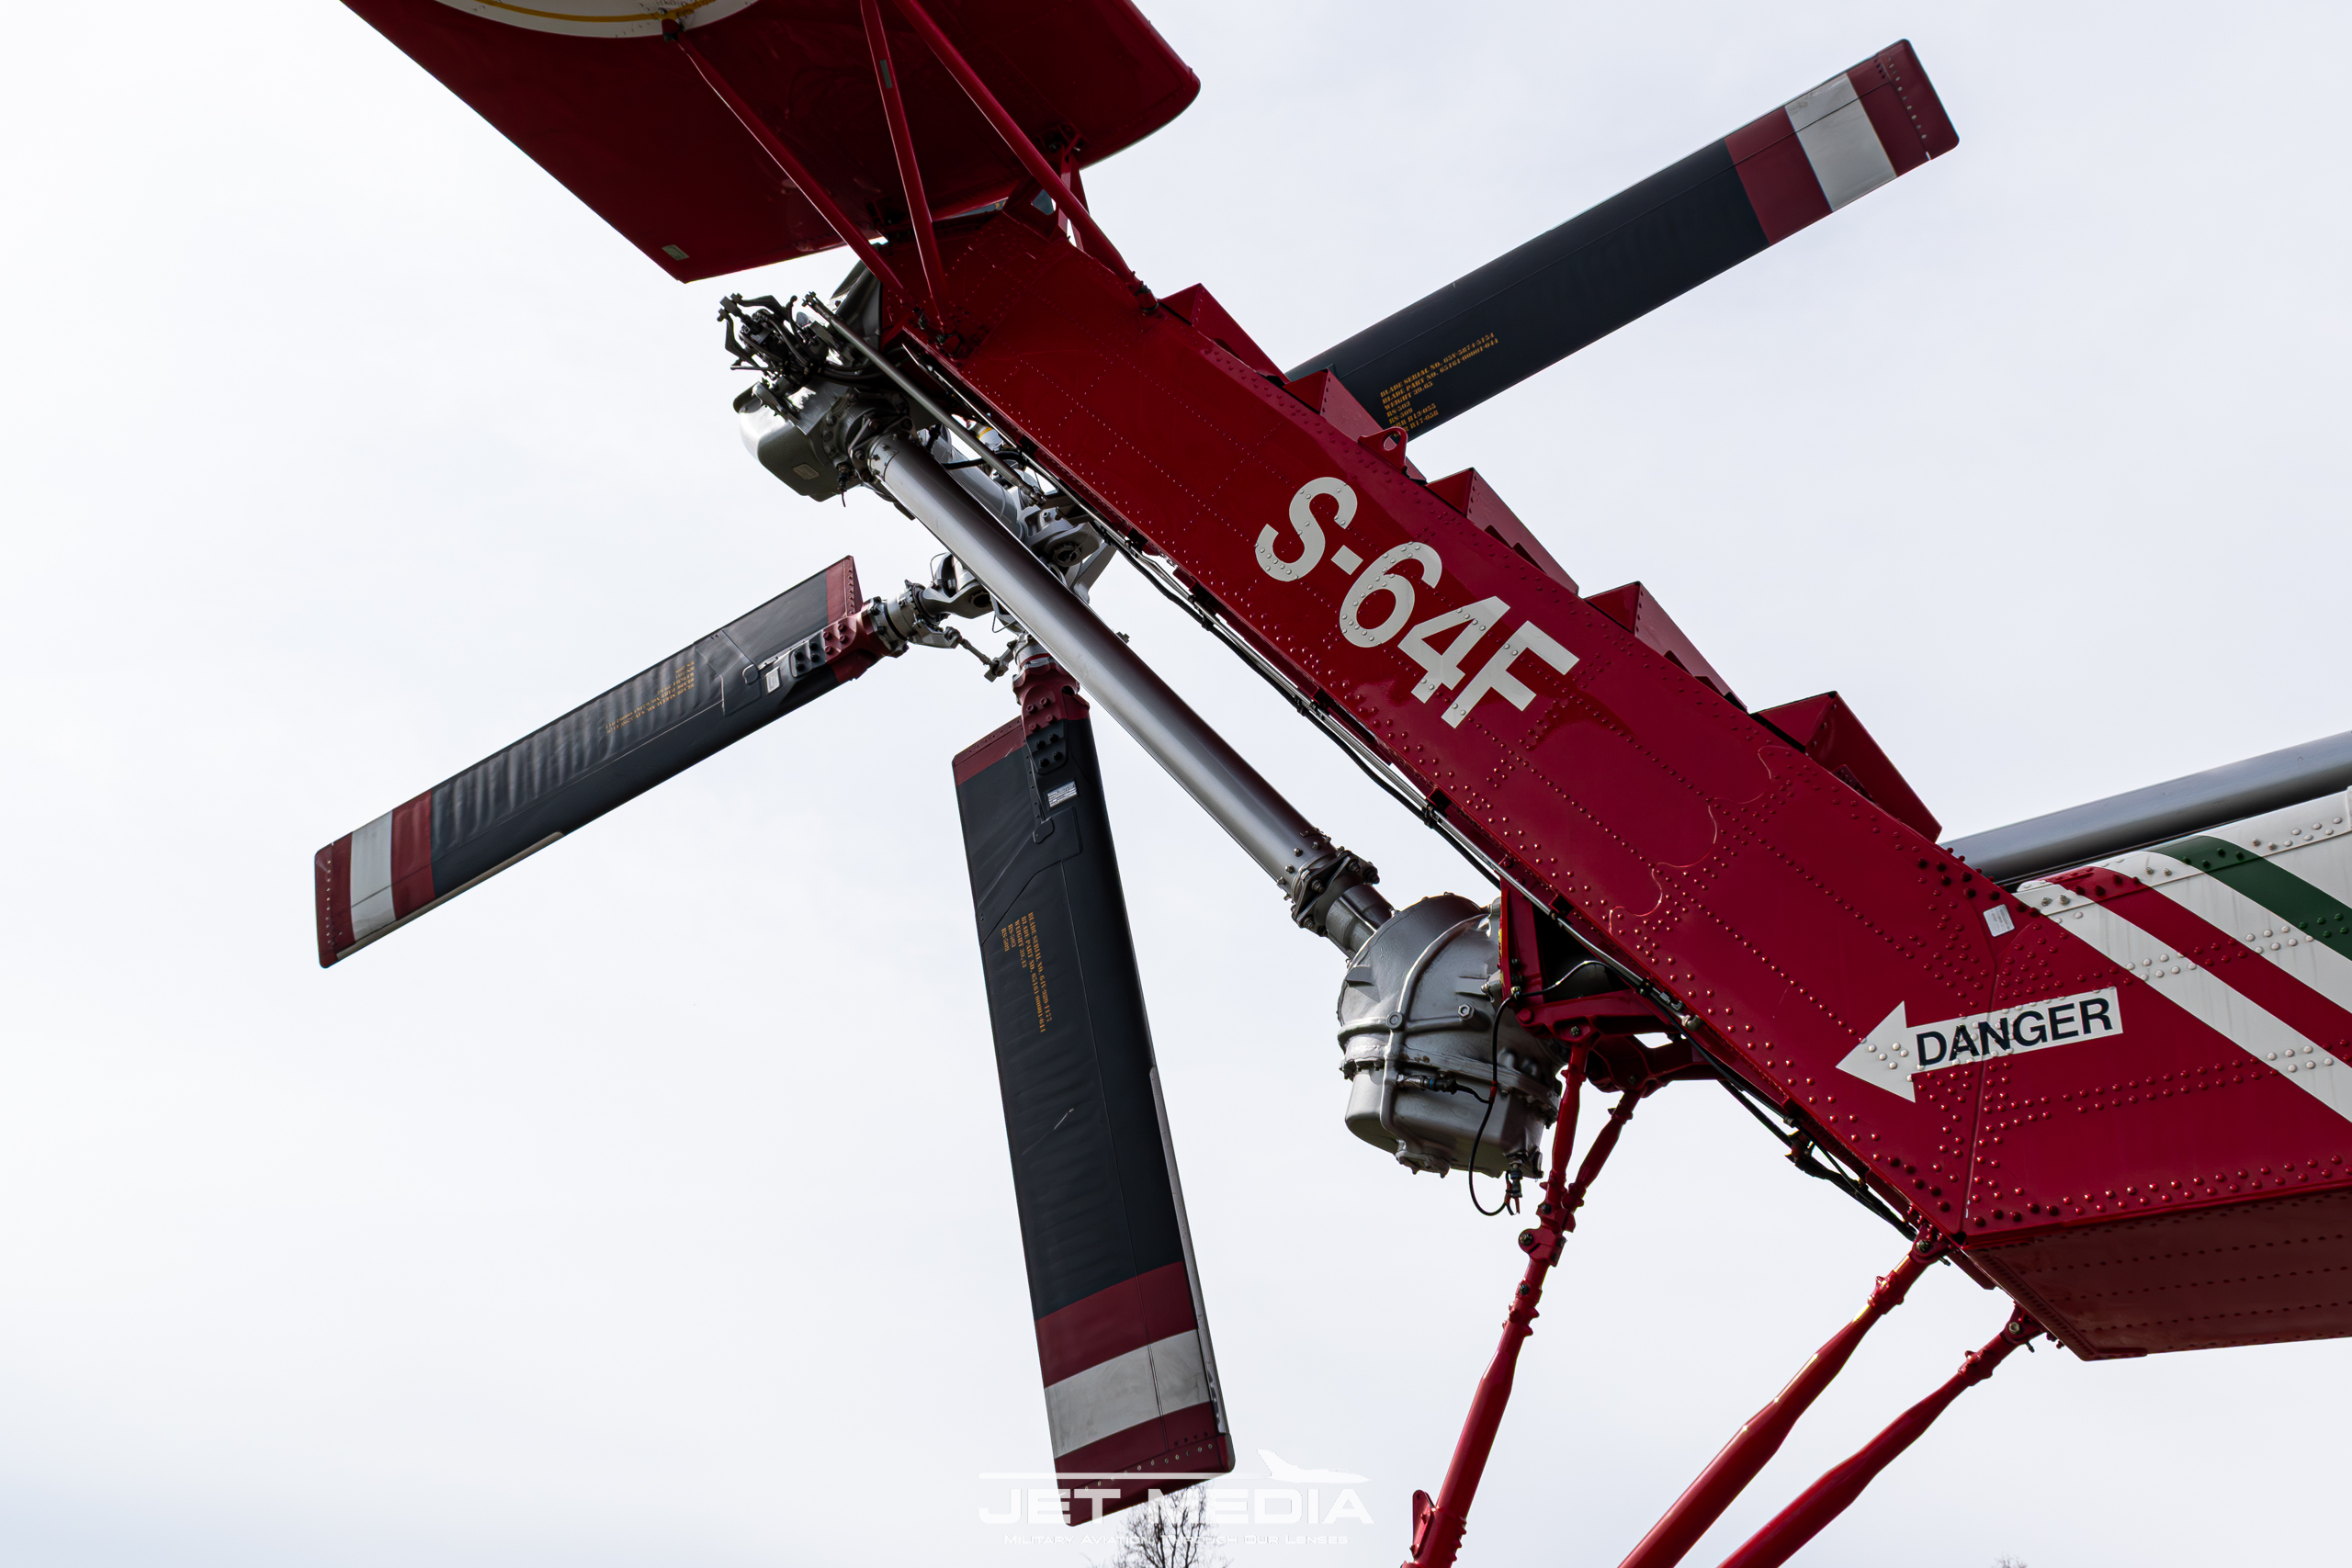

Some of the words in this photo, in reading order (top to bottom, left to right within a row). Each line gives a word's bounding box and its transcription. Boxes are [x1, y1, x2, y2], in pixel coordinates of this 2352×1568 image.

[1380, 382, 1402, 398] BLADE
[1404, 368, 1429, 384] SERIAL
[1382, 389, 1405, 404] BLADE
[1405, 377, 1426, 392] PART
[1426, 371, 1439, 381] NO.
[1385, 392, 1411, 410] WEIGHT
[1255, 477, 1579, 728] S-64F
[1015, 919, 1023, 947] WEIGHT
[1027, 912, 1037, 935] BLADE
[1033, 935, 1041, 961] SERIAL
[1917, 998, 2113, 1066] DANGER
